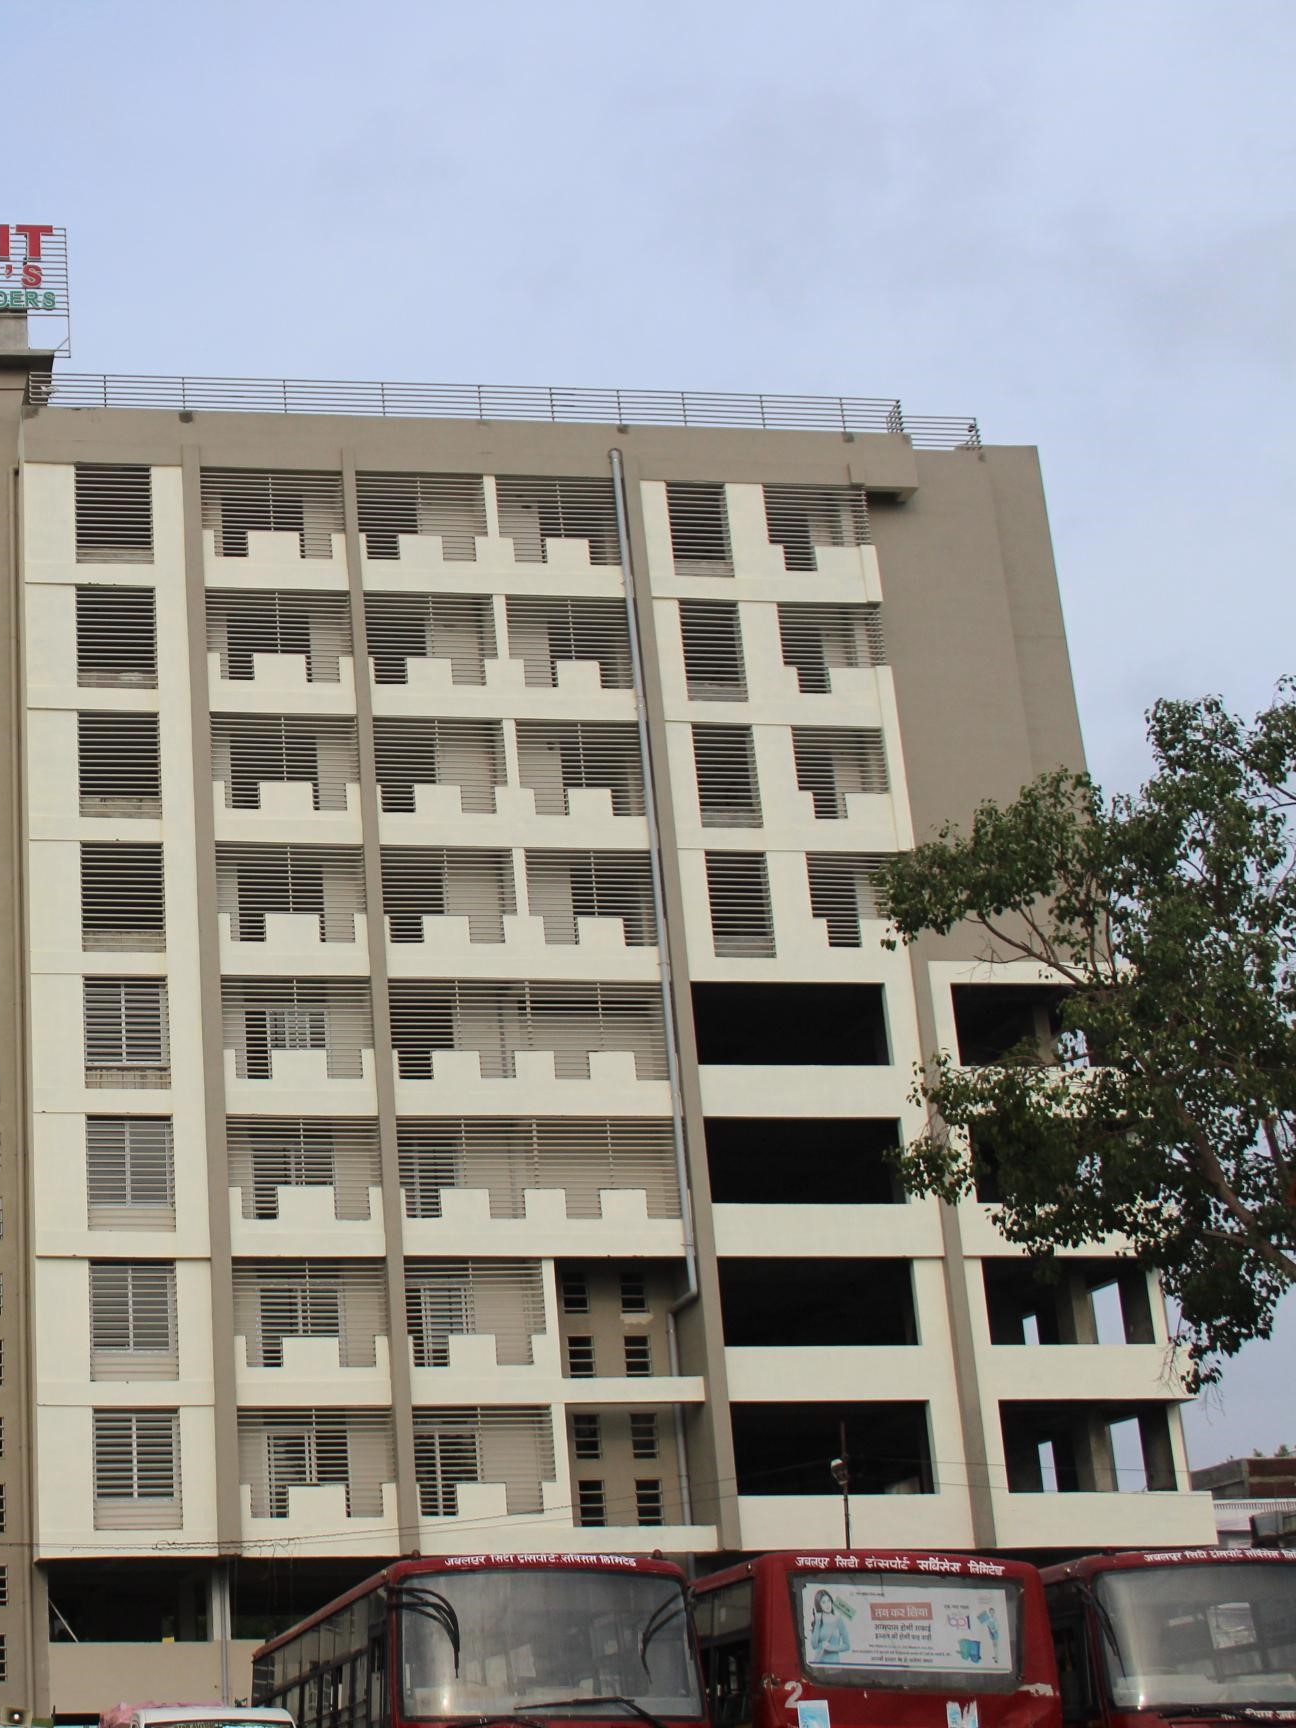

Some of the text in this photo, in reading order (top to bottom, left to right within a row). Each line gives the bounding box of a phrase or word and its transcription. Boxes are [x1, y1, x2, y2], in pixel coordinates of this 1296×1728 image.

[795, 1556, 830, 1569] जबलपुर
[835, 1555, 859, 1568] सिटी
[967, 1560, 1005, 1576] लिमिटेड
[785, 1680, 803, 1708] 2
